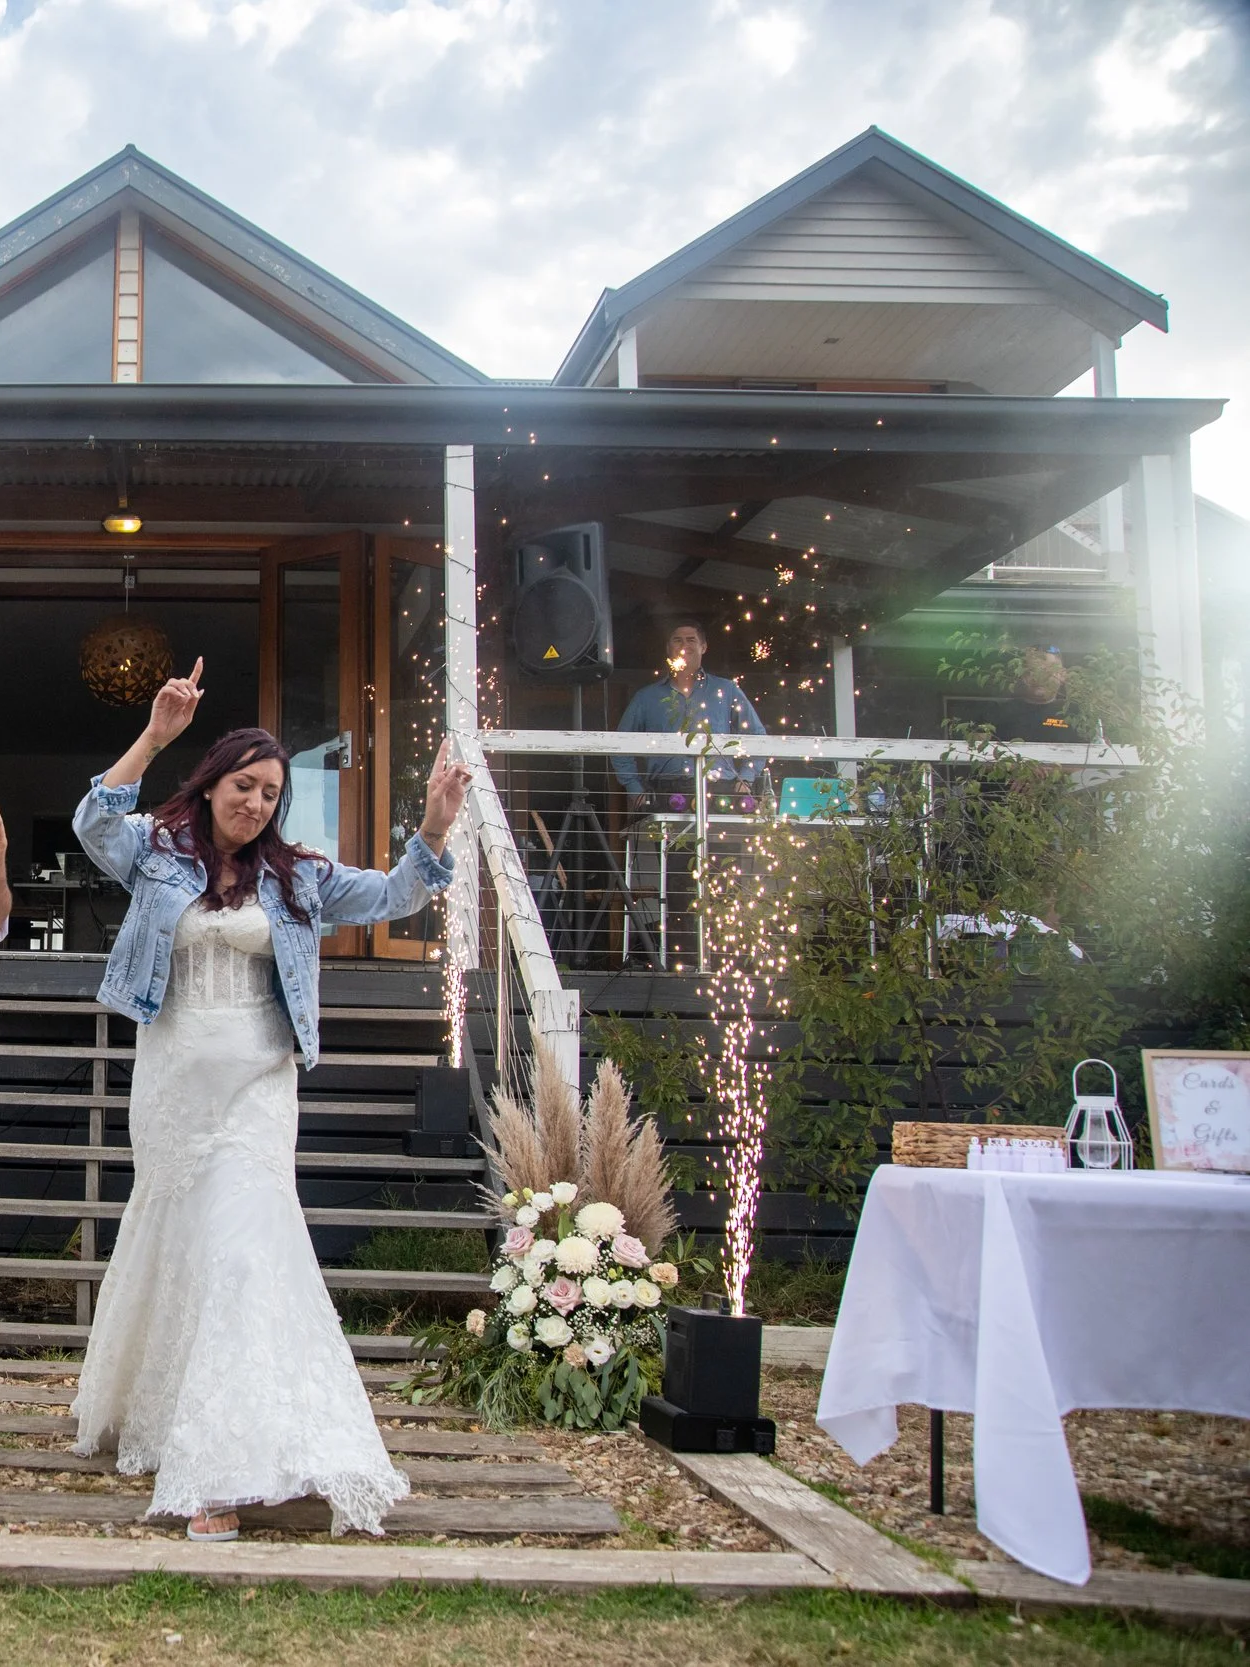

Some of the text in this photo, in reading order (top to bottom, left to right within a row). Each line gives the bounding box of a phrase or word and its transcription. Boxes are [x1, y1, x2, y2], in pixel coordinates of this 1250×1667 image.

[1182, 1072, 1235, 1090] Cards
[1204, 1100, 1220, 1115] &
[1193, 1123, 1238, 1147] Gifts
